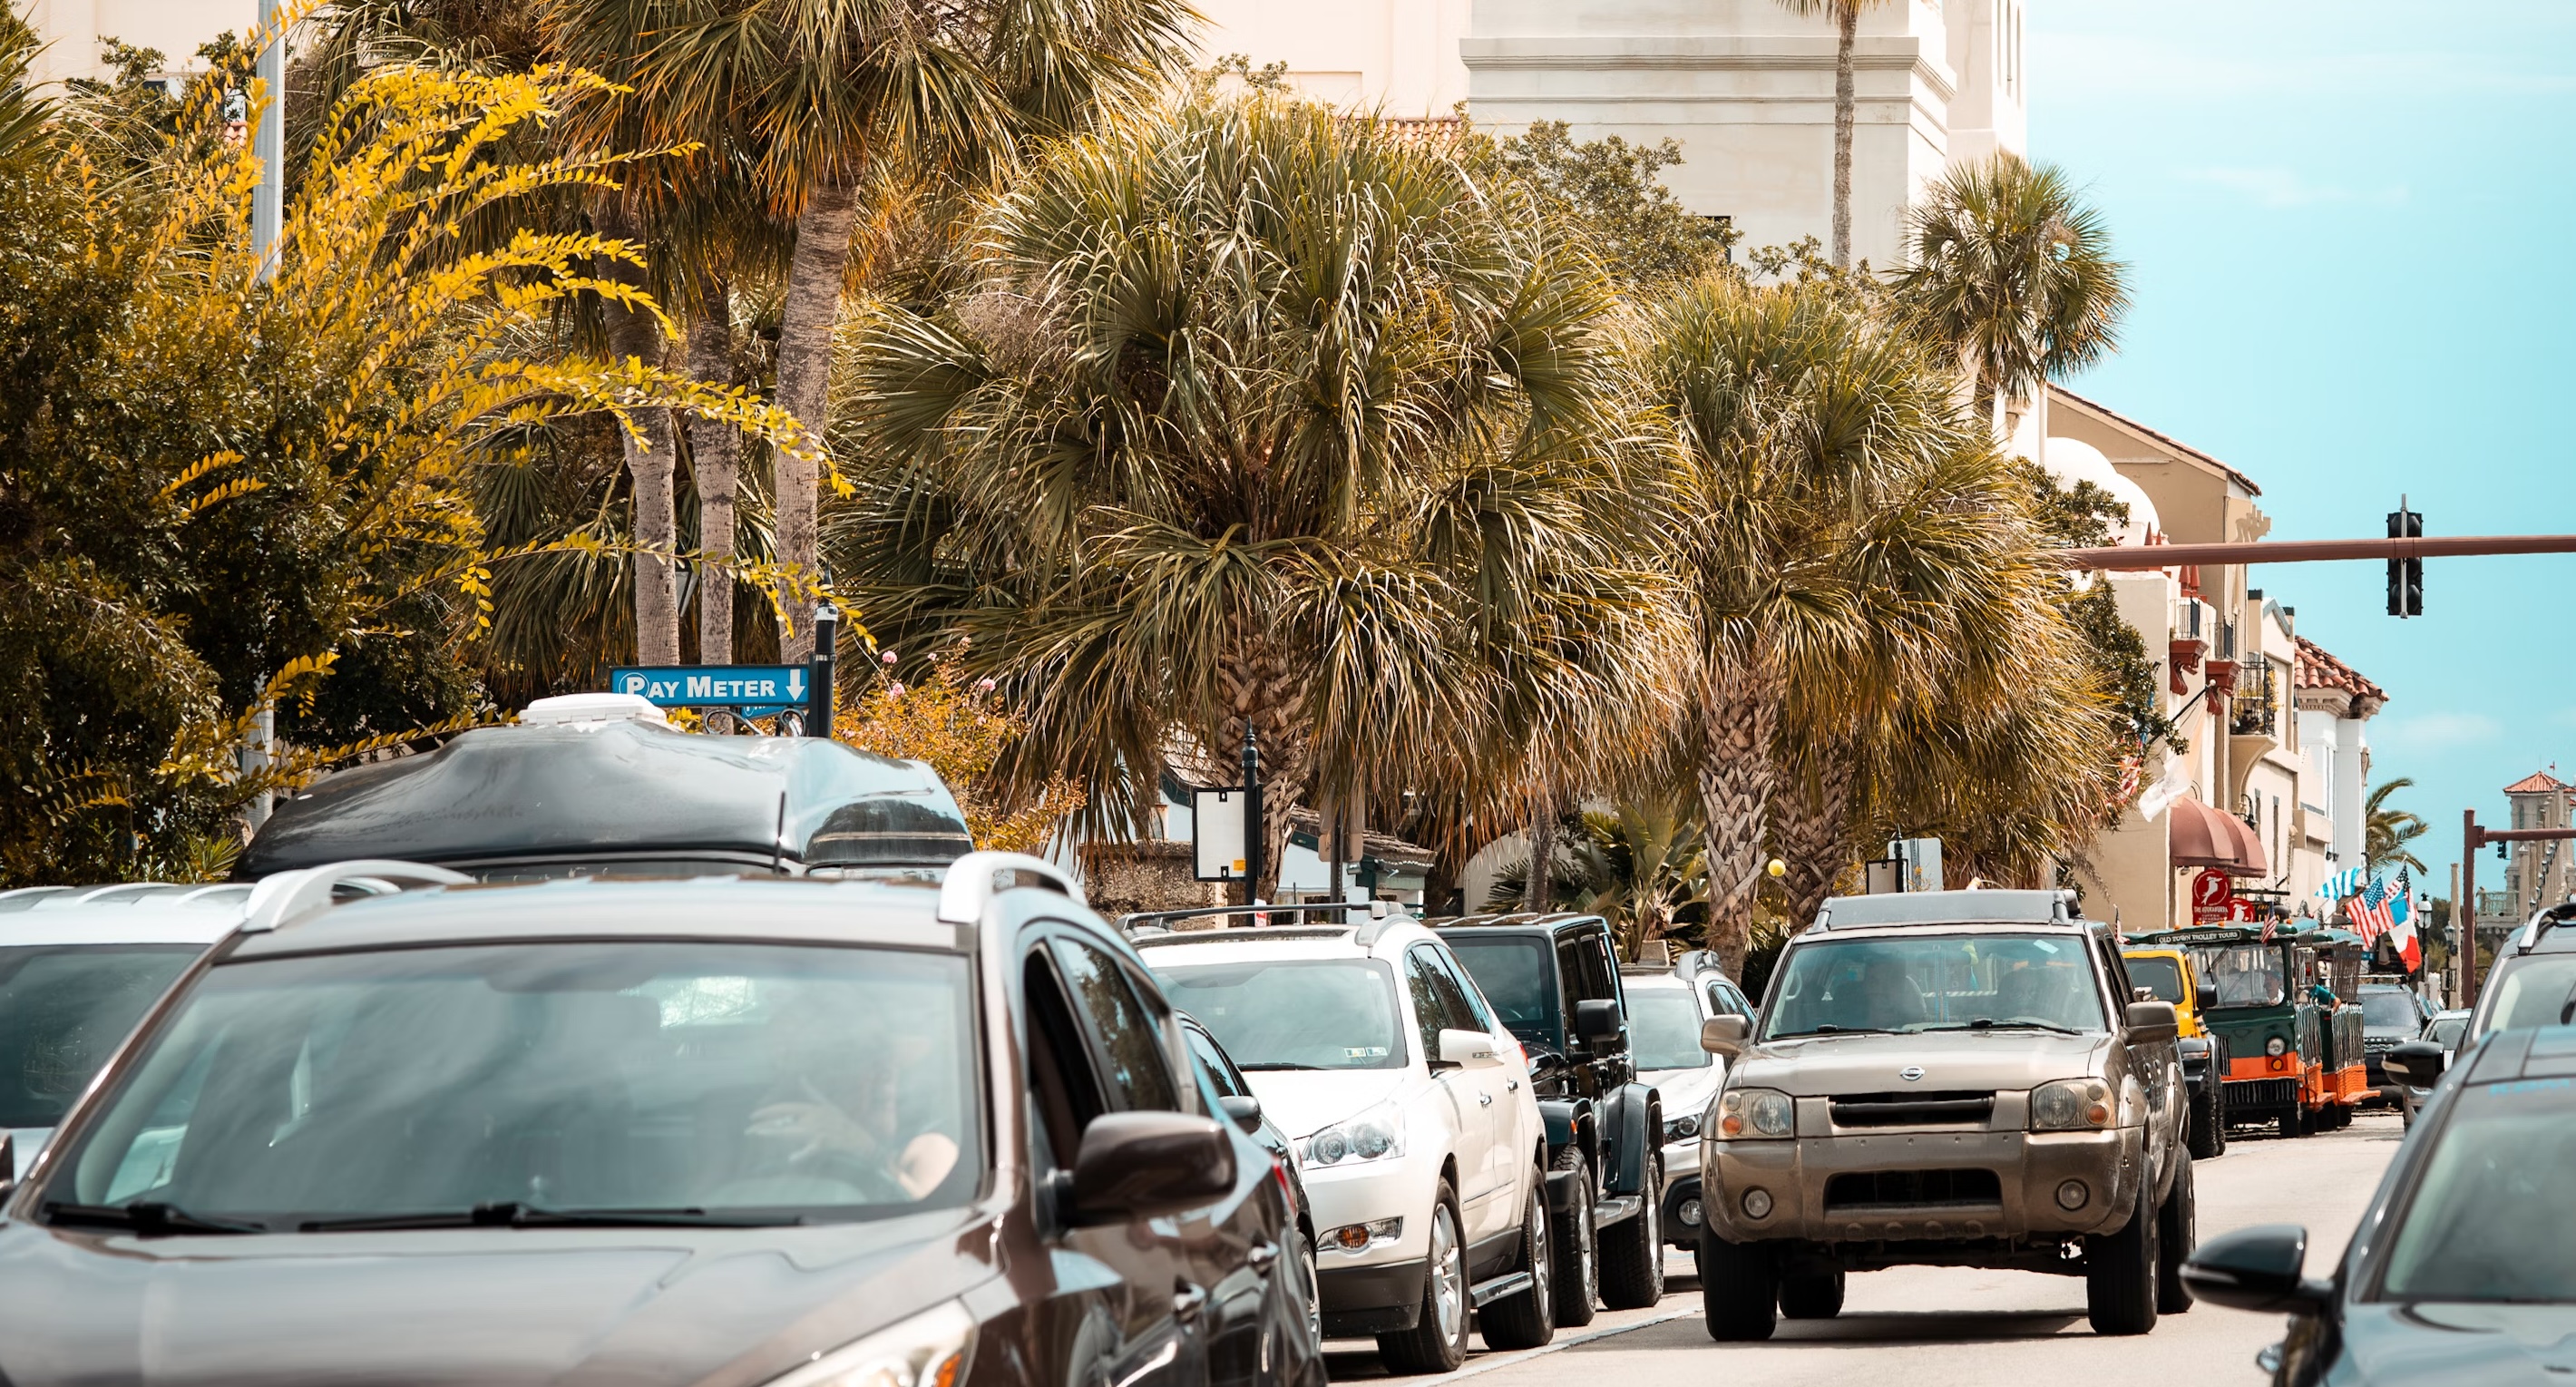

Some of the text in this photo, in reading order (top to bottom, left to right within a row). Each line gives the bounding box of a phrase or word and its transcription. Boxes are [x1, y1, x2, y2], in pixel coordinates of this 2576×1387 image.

[687, 676, 776, 698] METER
[2171, 934, 2191, 943] TOWN
[2191, 933, 2217, 941] TROLLEY
